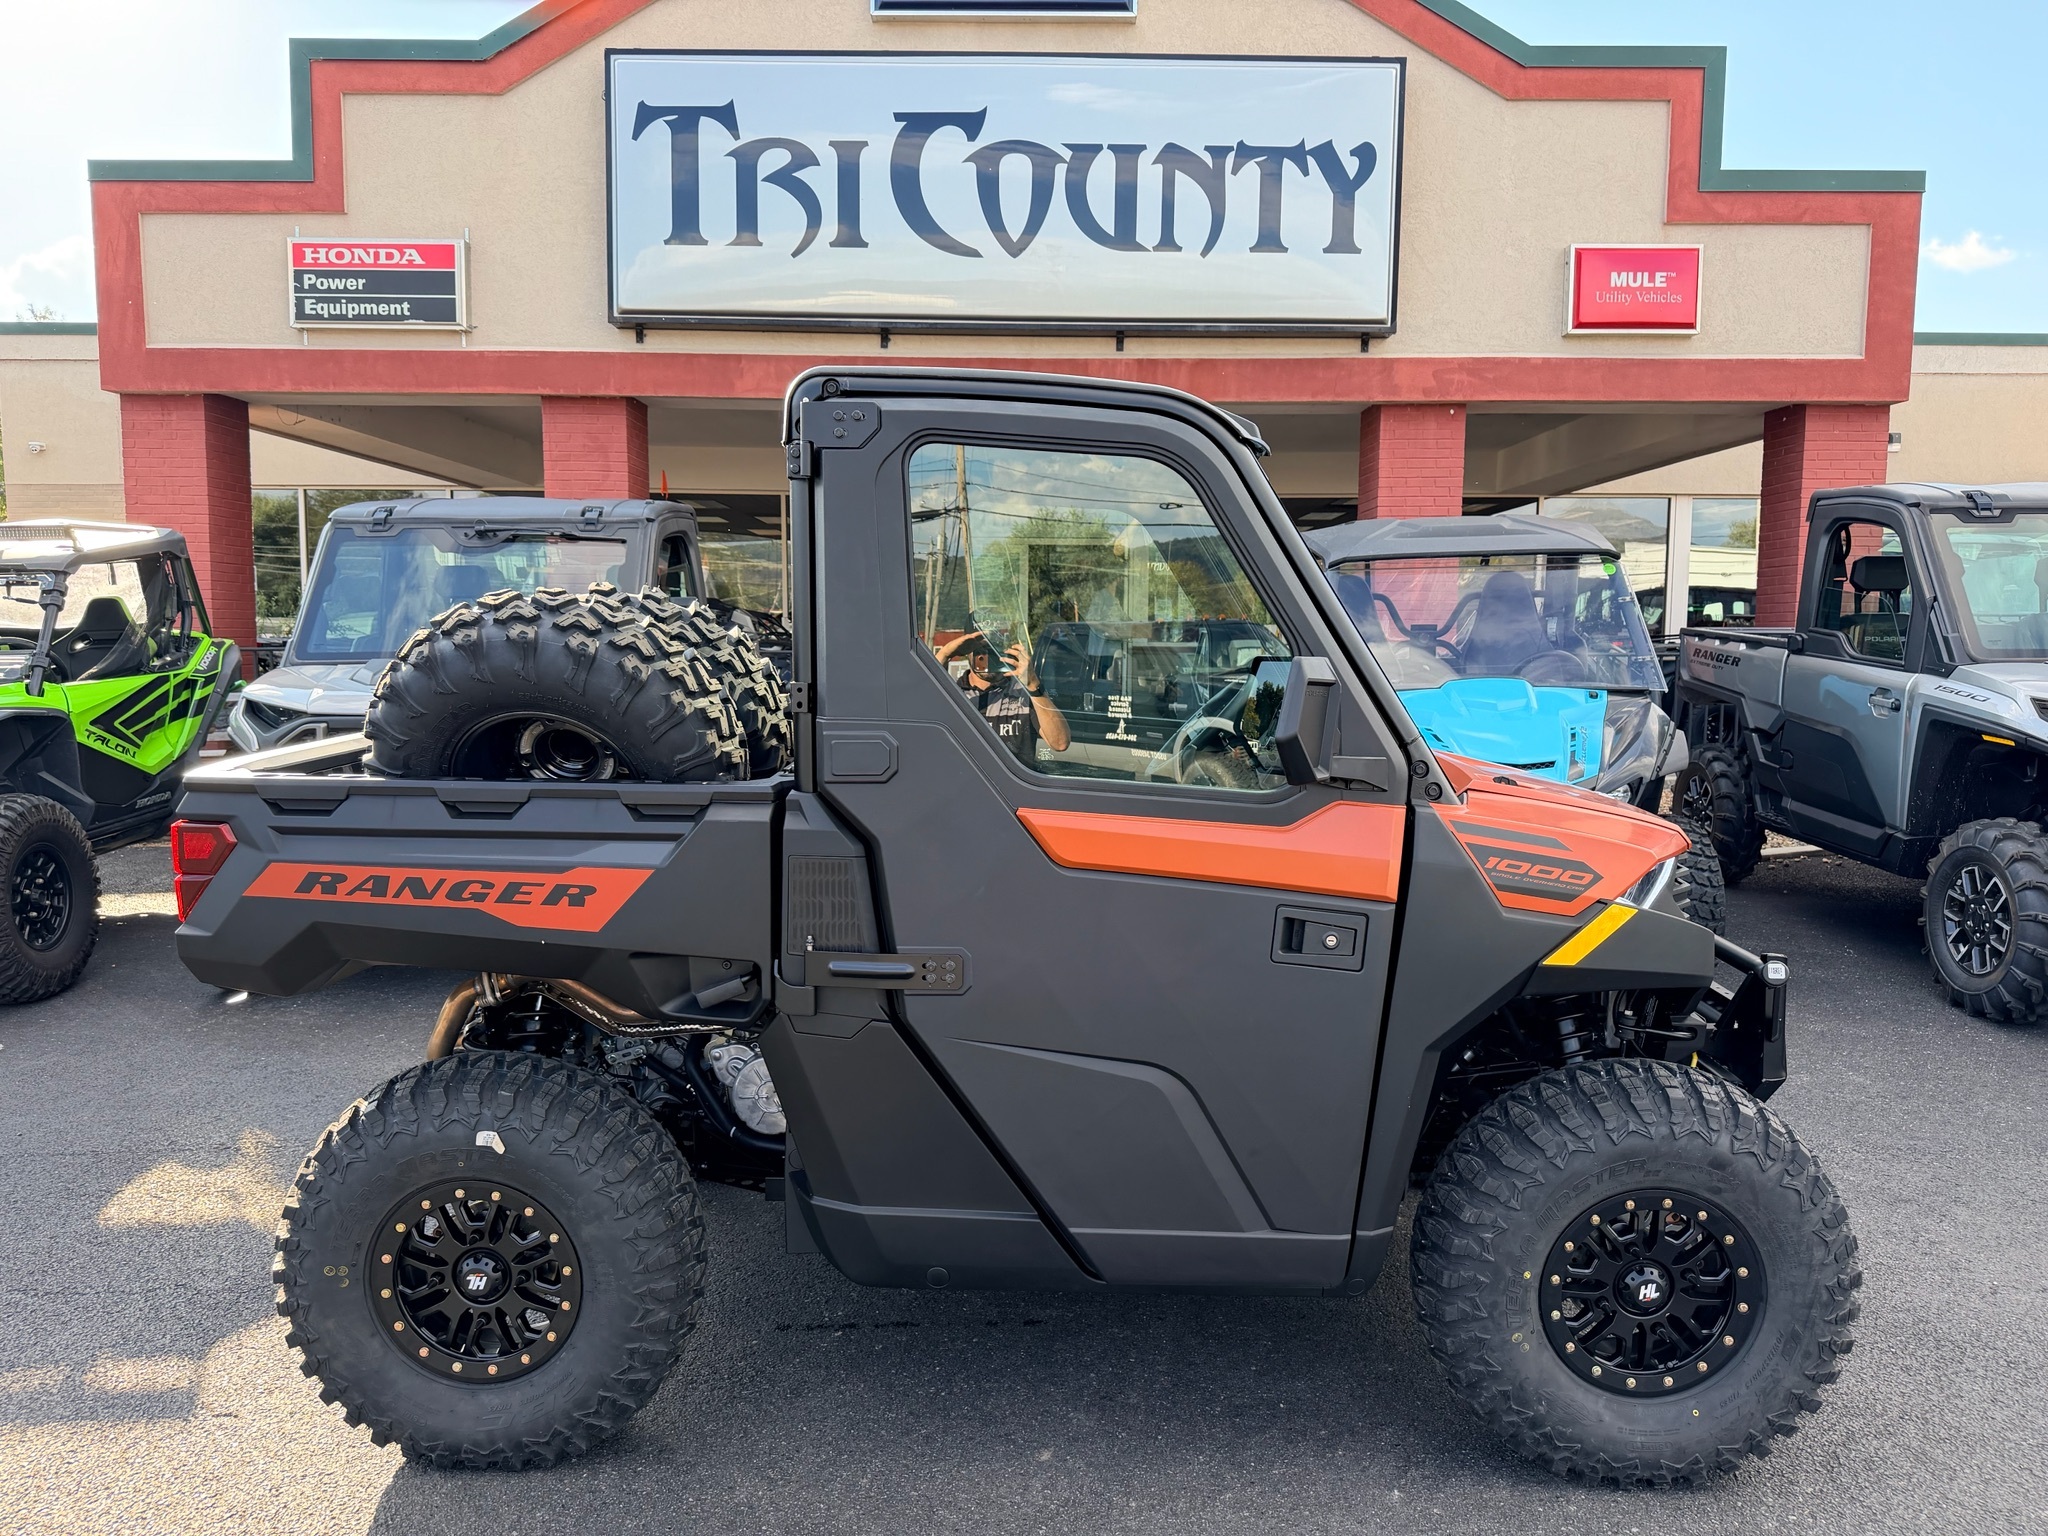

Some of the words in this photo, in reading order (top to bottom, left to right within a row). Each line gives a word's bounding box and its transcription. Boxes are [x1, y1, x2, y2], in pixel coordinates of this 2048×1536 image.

[302, 247, 426, 265] HONDA
[303, 273, 366, 290] Power
[1595, 291, 1633, 306] Utility
[1636, 291, 1683, 303] Vehicles
[304, 299, 411, 318] Equipment
[1692, 647, 1742, 668] RANGER
[1711, 663, 1725, 671] DUTY
[1933, 685, 1992, 703] 1500
[85, 728, 137, 759] TALON
[135, 791, 172, 809] HONDA
[1484, 856, 1594, 885] 1000
[1490, 871, 1521, 881] SINGLE
[1523, 877, 1566, 888] OVERHEAD
[293, 870, 599, 908] RANGER
[1638, 1282, 1660, 1300] HL
